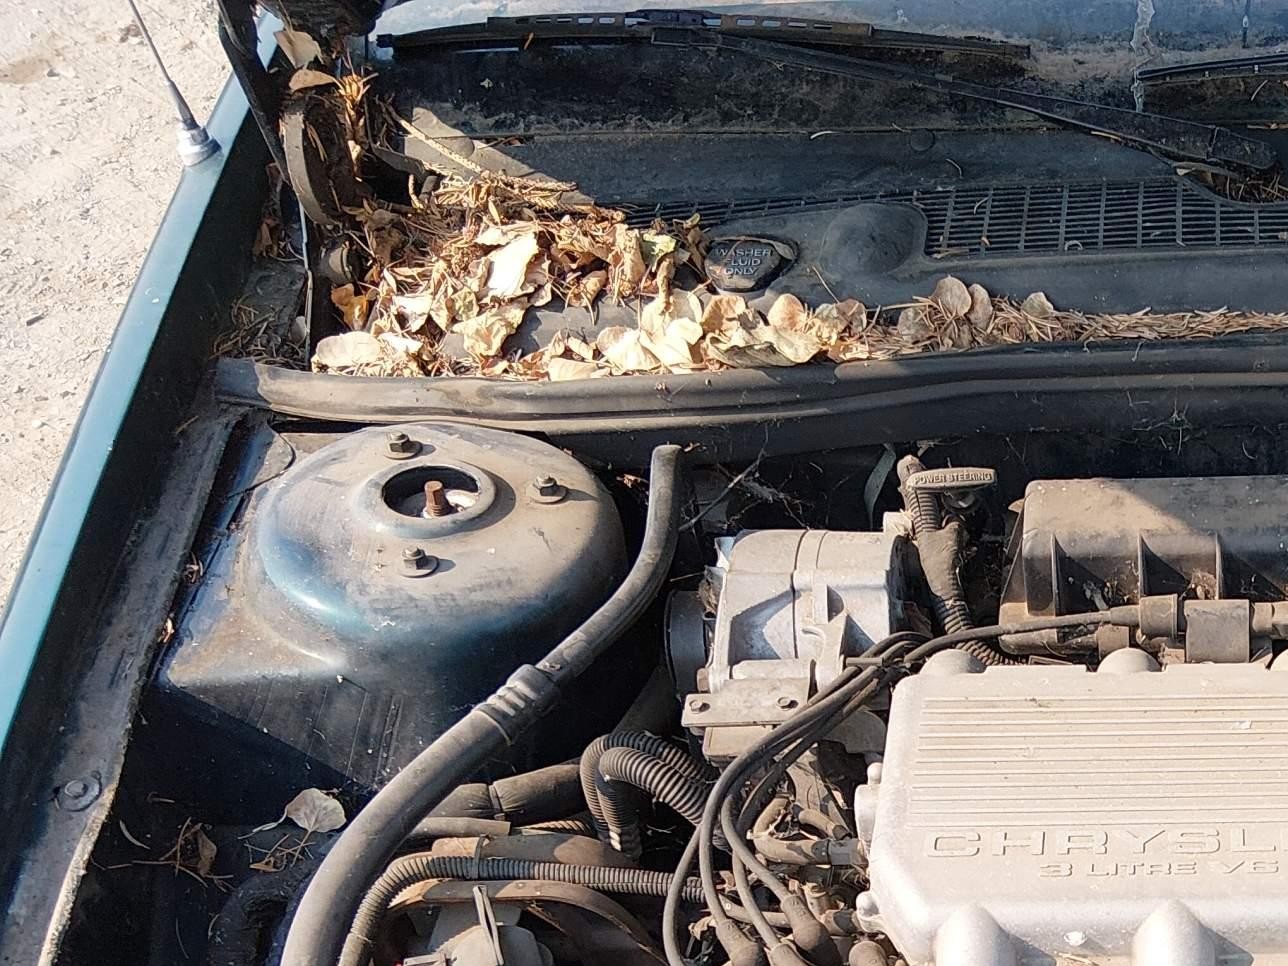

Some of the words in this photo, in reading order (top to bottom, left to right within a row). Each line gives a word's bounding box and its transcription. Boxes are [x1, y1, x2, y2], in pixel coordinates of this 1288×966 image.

[723, 267, 757, 275] ONLY
[914, 474, 946, 484] POWER
[949, 471, 992, 482] STEERING
[1040, 863, 1073, 877] 3
[1087, 861, 1197, 876] LITRE
[1222, 860, 1279, 874] V6
